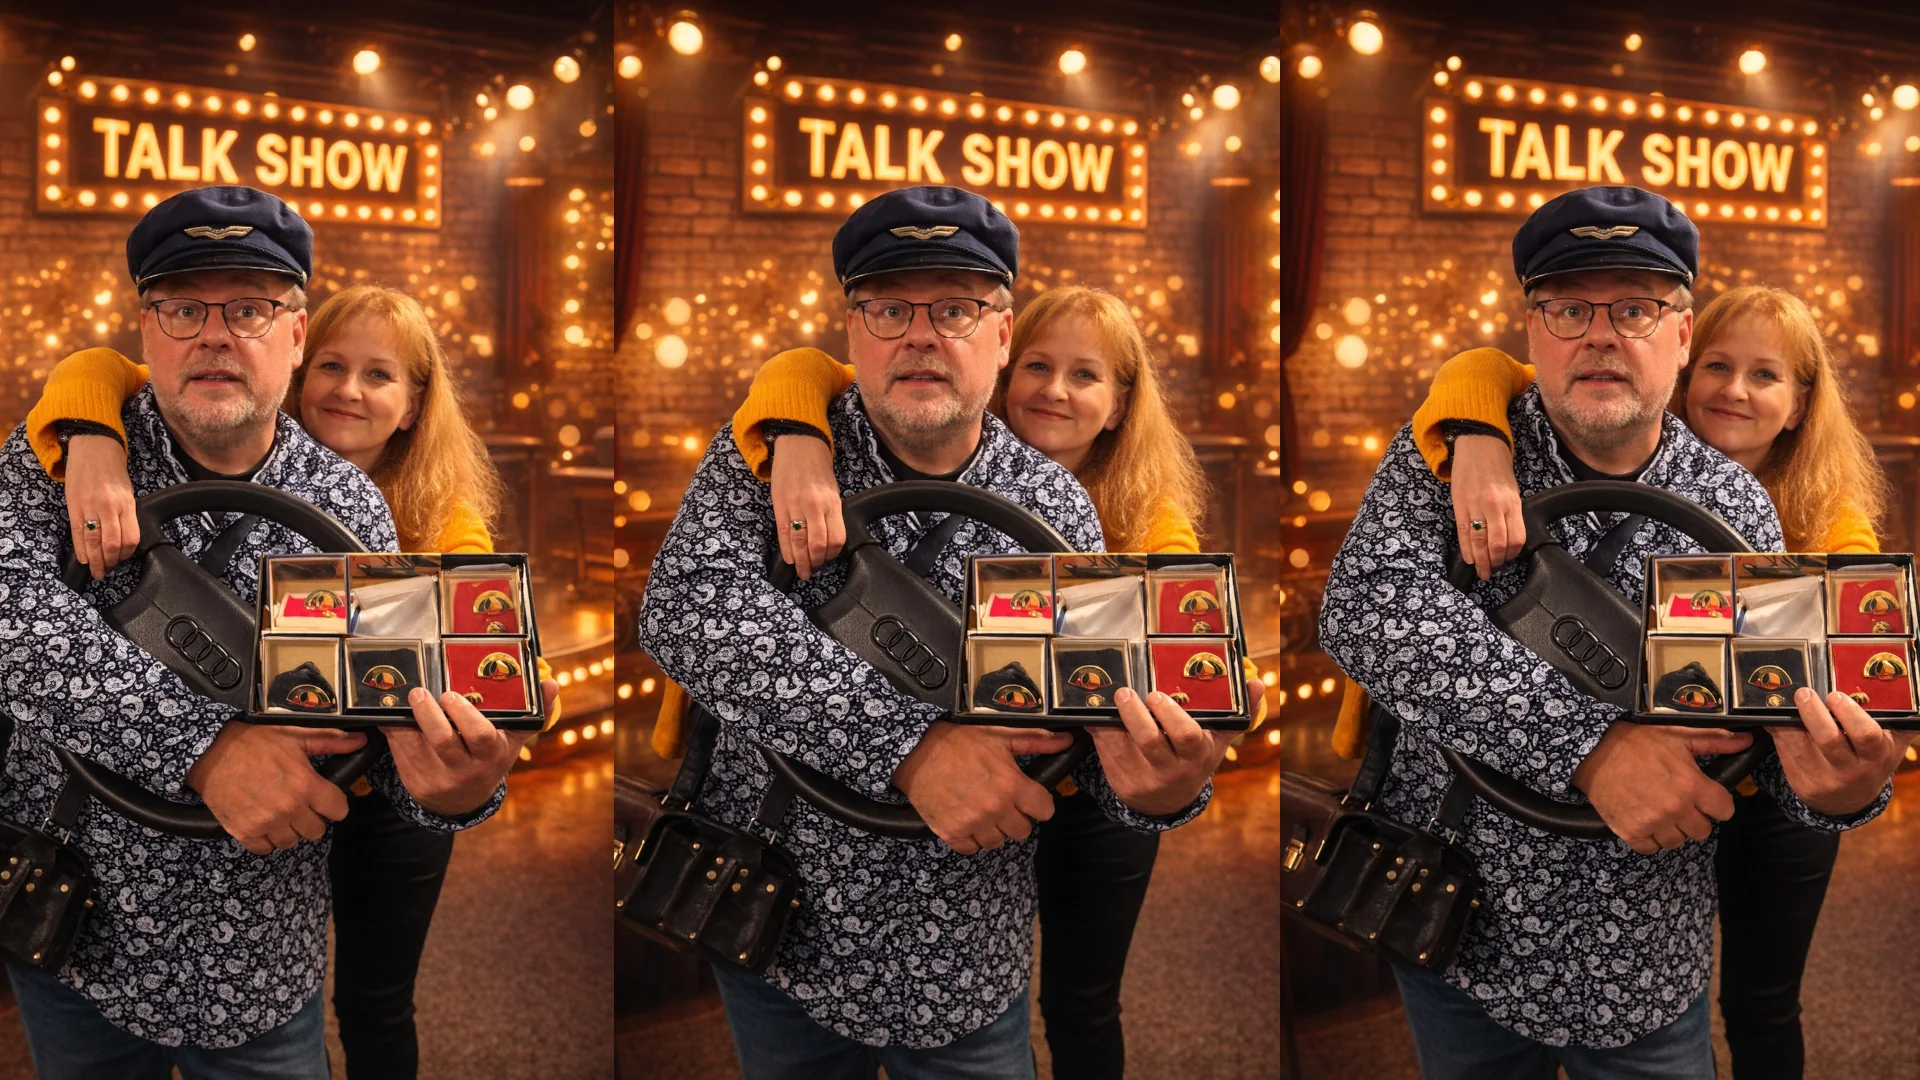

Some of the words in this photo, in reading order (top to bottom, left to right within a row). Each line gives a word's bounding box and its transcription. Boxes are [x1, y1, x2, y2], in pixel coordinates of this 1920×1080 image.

[94, 118, 239, 183] TALK
[257, 134, 407, 192] SHOW
[800, 118, 945, 183] TALK
[963, 134, 1113, 192] SHOW
[1480, 118, 1625, 183] TALK
[1643, 134, 1793, 192] SHOW
